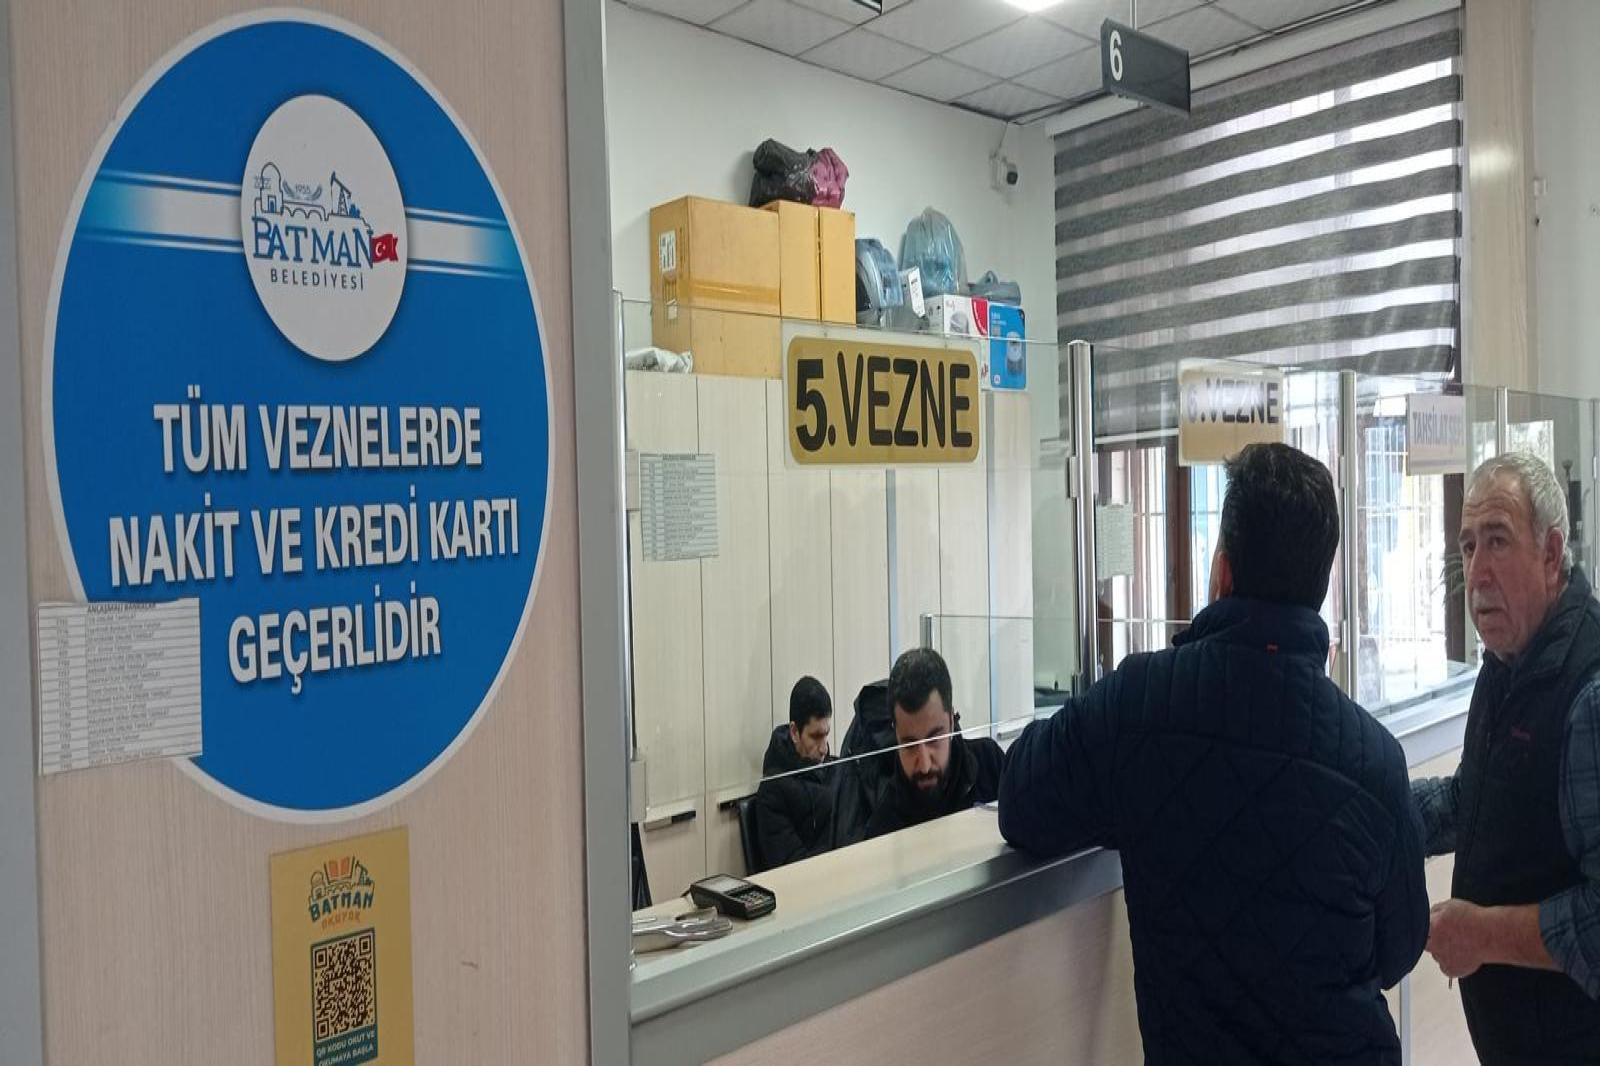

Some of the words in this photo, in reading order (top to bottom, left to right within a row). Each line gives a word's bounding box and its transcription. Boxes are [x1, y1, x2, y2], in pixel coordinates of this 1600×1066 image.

[1110, 30, 1123, 81] 6
[252, 216, 373, 269] BATMAN
[270, 268, 364, 291] BELEDİYESİ
[153, 384, 248, 473] TÜM
[258, 404, 482, 470] VEZNELERDE
[796, 350, 973, 453] 5.VEZNE
[109, 492, 240, 587] NAKİT
[251, 508, 303, 575] VE
[314, 484, 419, 570] KREDİ
[429, 498, 519, 561] KARTI
[228, 581, 441, 695] GEÇERLİDİR
[310, 891, 375, 922] BATMAN
